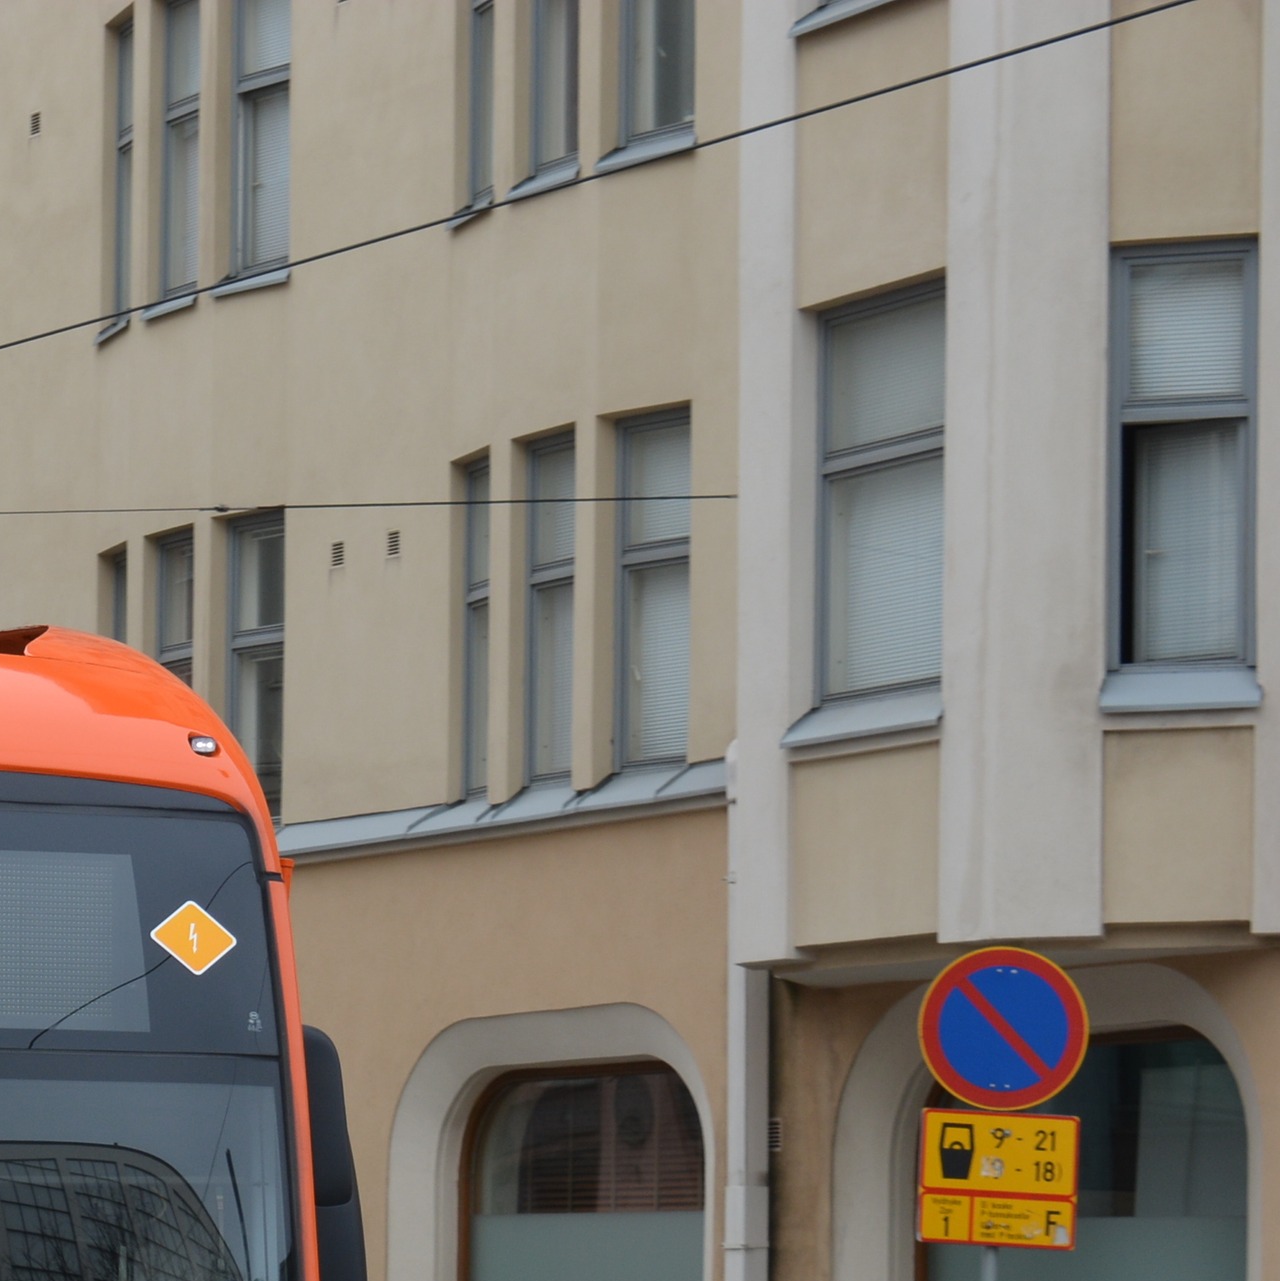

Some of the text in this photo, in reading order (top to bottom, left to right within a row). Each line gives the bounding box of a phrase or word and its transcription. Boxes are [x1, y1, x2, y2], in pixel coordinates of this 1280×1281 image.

[991, 1127, 1006, 1149] 9
[1035, 1130, 1056, 1152] 21
[1045, 1210, 1061, 1236] F
